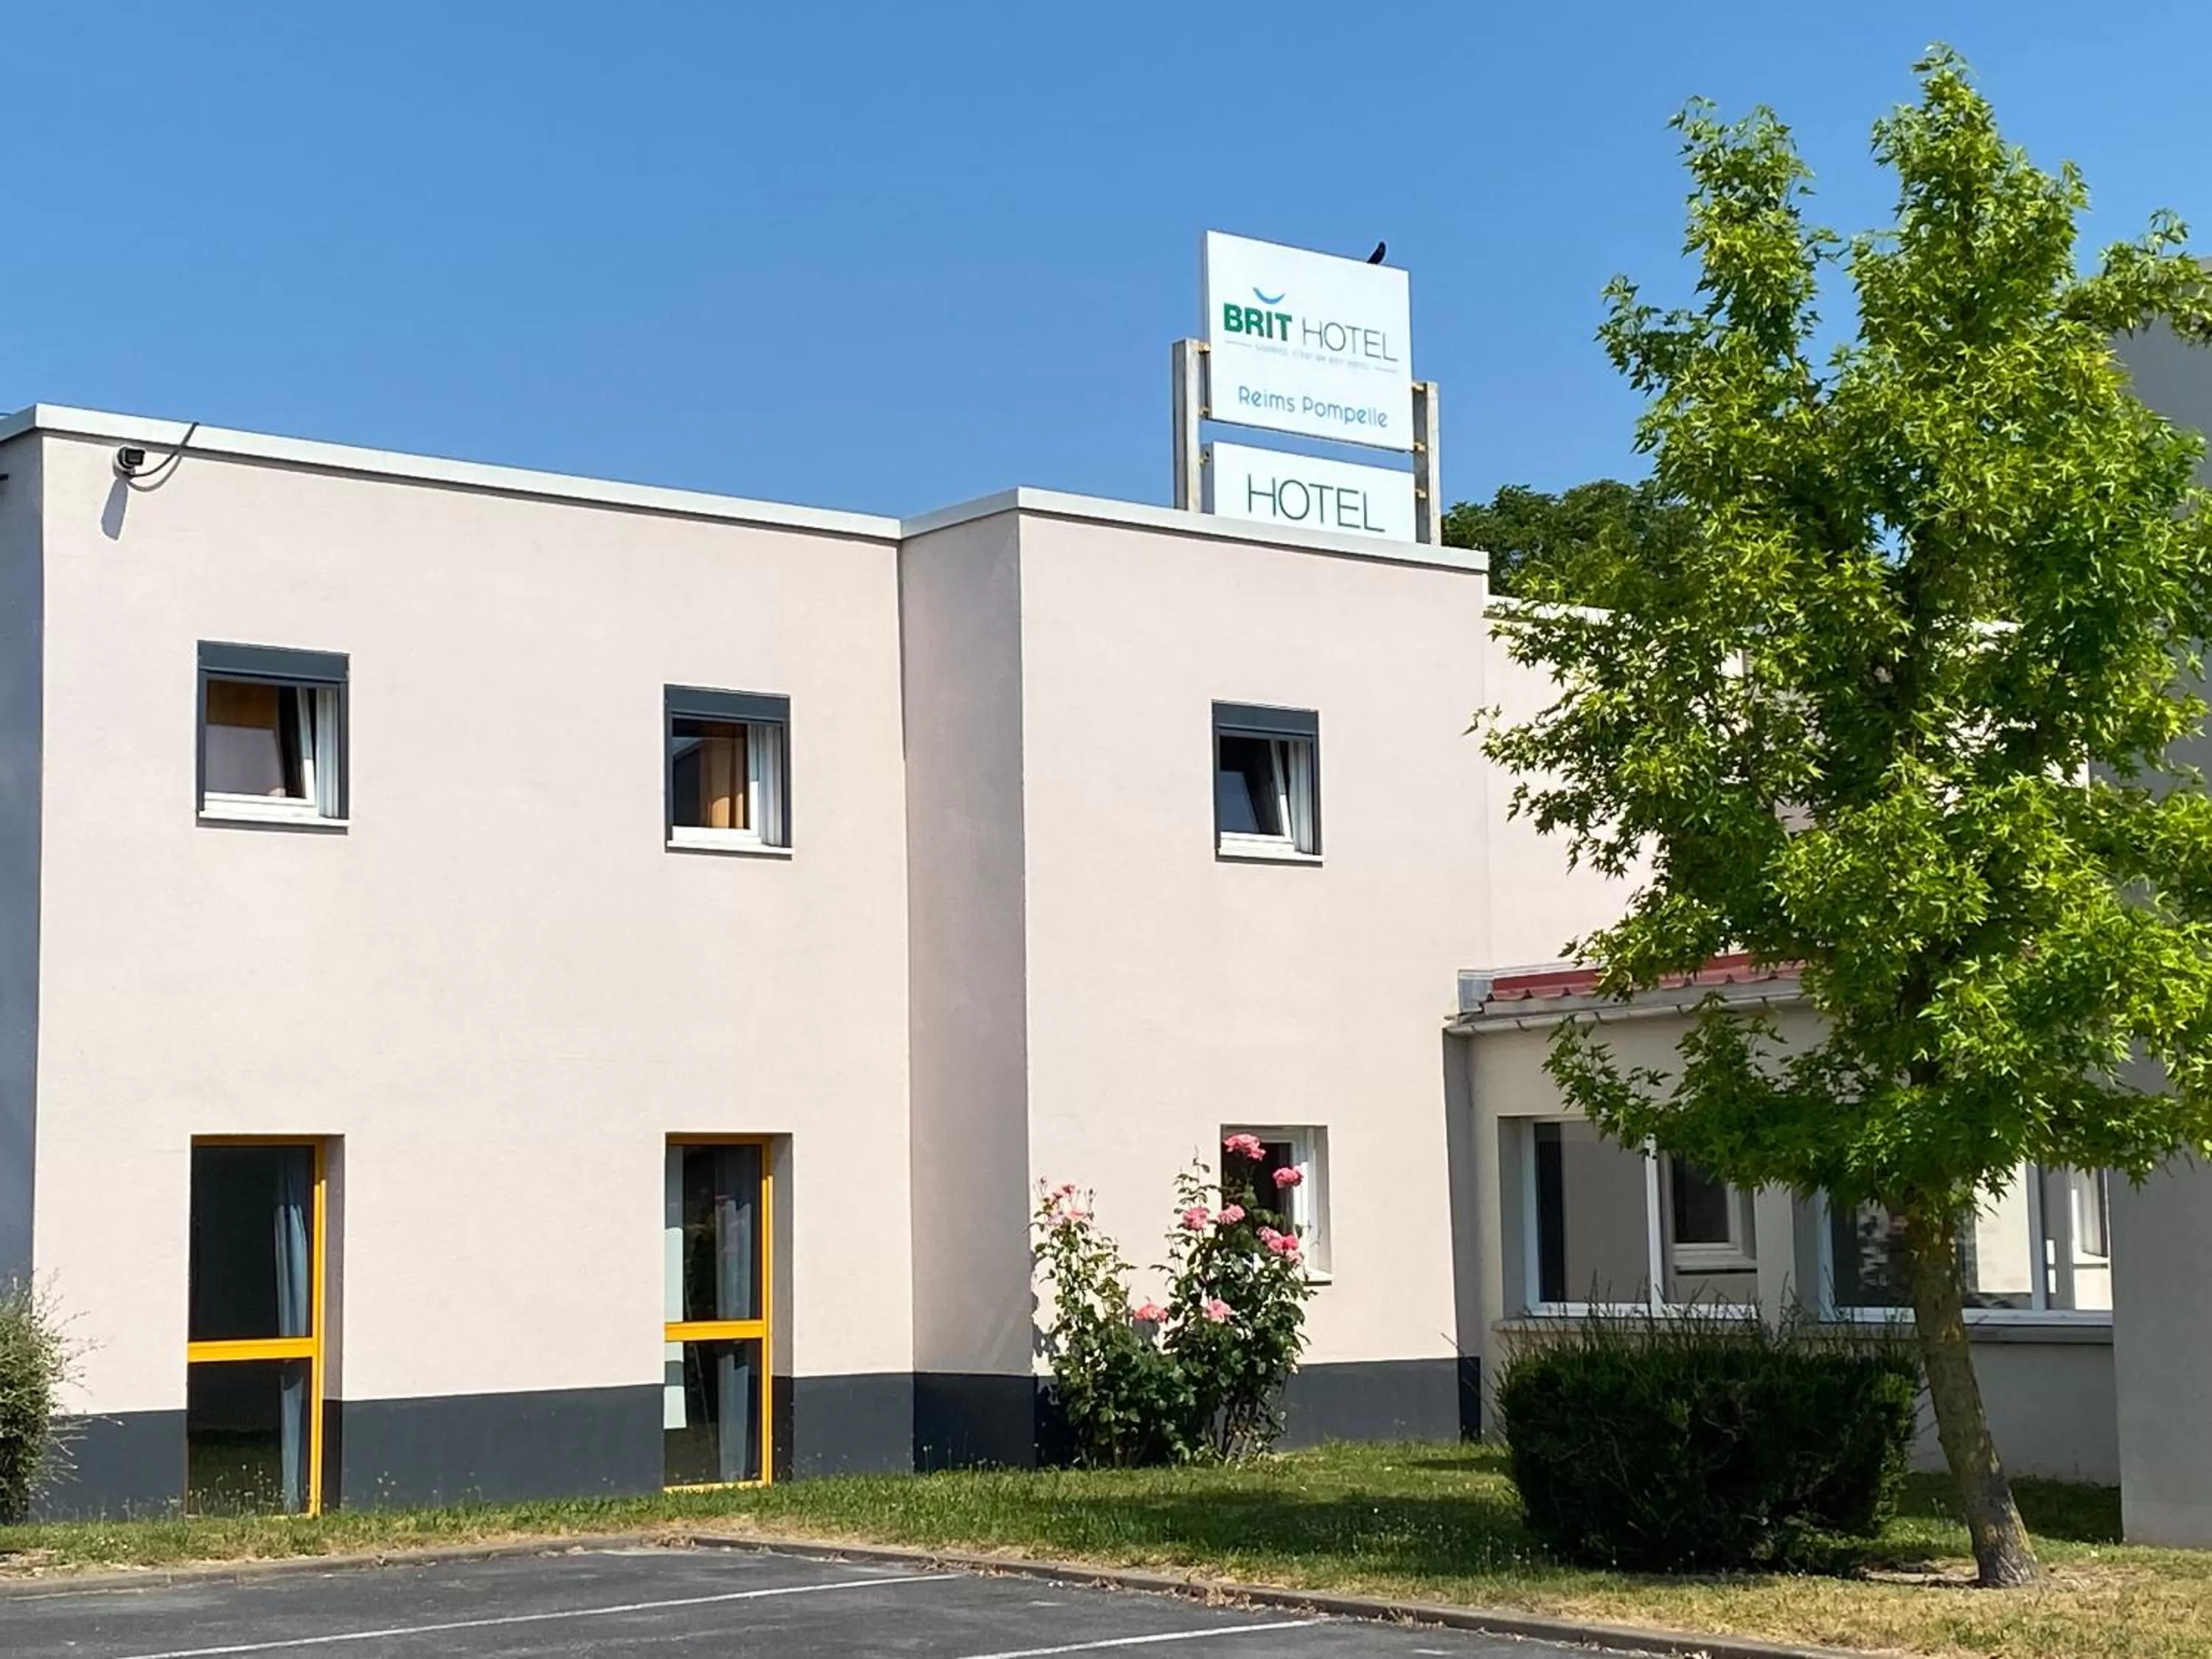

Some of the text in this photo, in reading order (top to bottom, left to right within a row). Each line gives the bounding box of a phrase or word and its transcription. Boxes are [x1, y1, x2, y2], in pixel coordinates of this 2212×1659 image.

[1223, 302, 1293, 341] BRIT
[1302, 318, 1399, 362] HOTEL
[1238, 386, 1388, 428] Reims Pompelle
[1247, 473, 1385, 533] HOTEL
